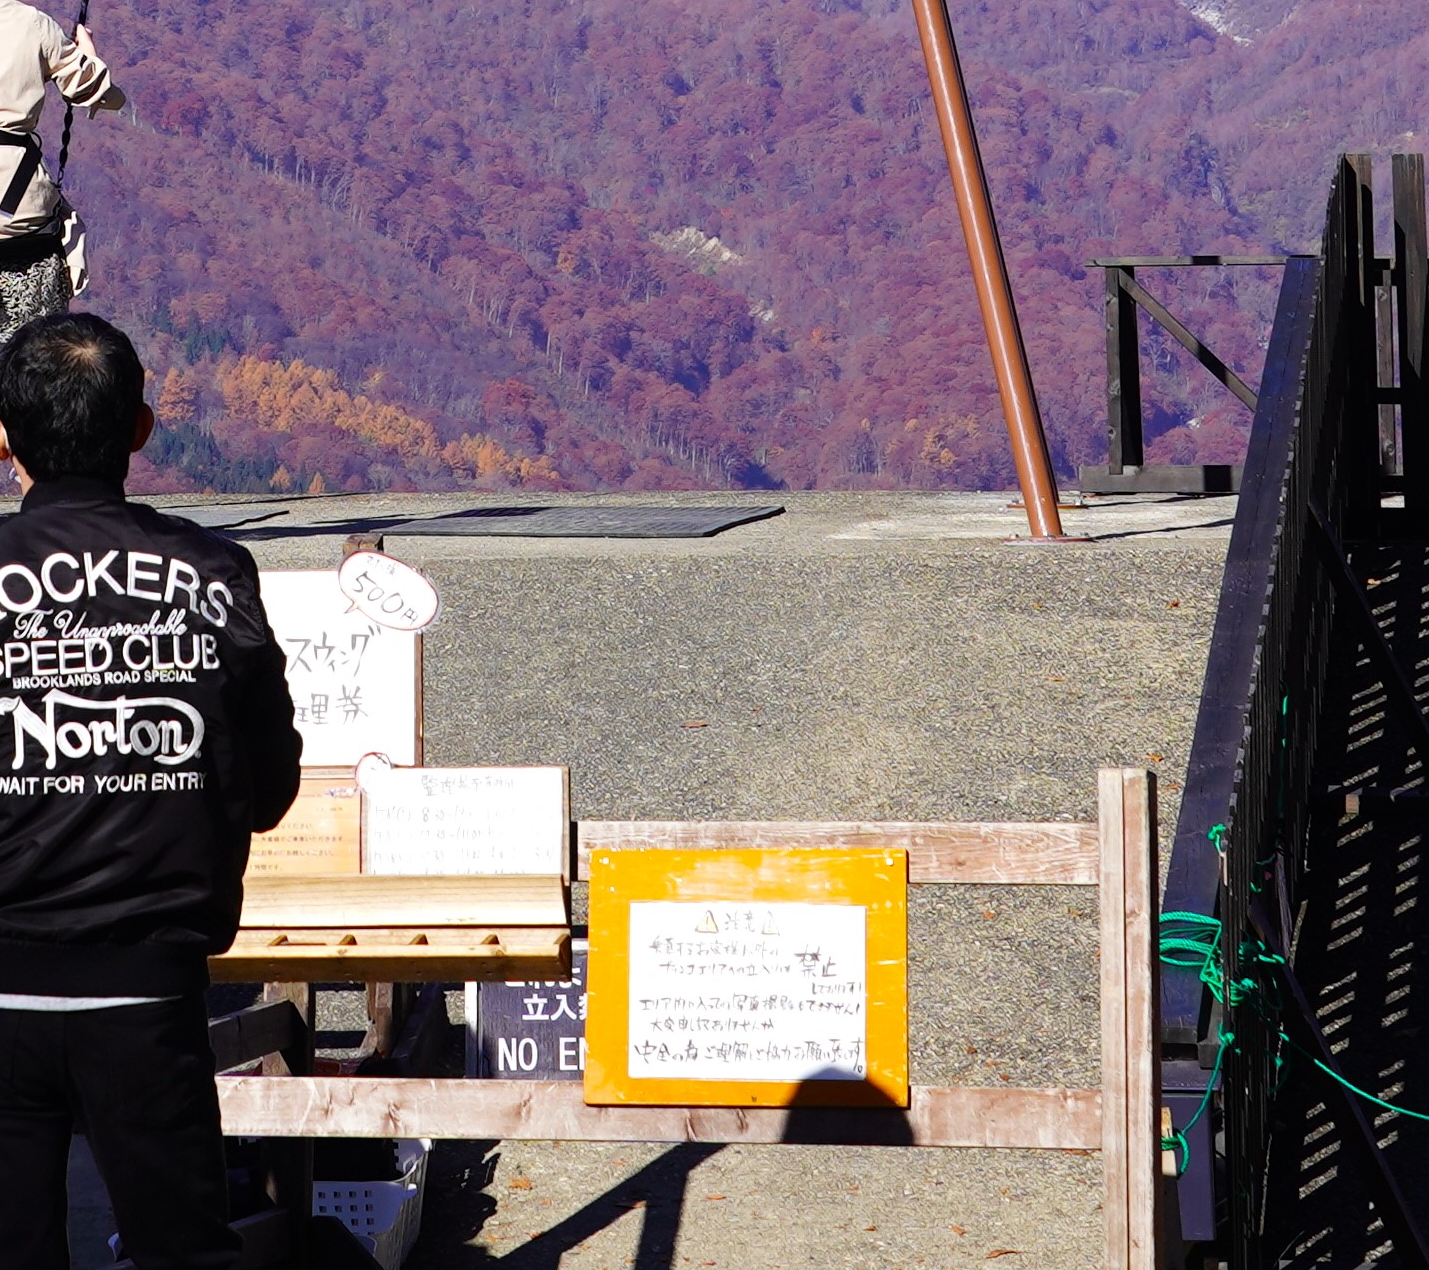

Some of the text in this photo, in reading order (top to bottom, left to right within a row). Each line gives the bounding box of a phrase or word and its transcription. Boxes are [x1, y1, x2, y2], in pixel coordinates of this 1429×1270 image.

[13, 608, 54, 640] The
[123, 634, 220, 671] CLUB
[12, 670, 197, 690] BROOKLANDS ROAD SPECIAL
[43, 776, 85, 794] FOR
[94, 774, 146, 794] YOUR
[151, 771, 207, 791] ENTRY
[498, 1037, 538, 1071] NO
